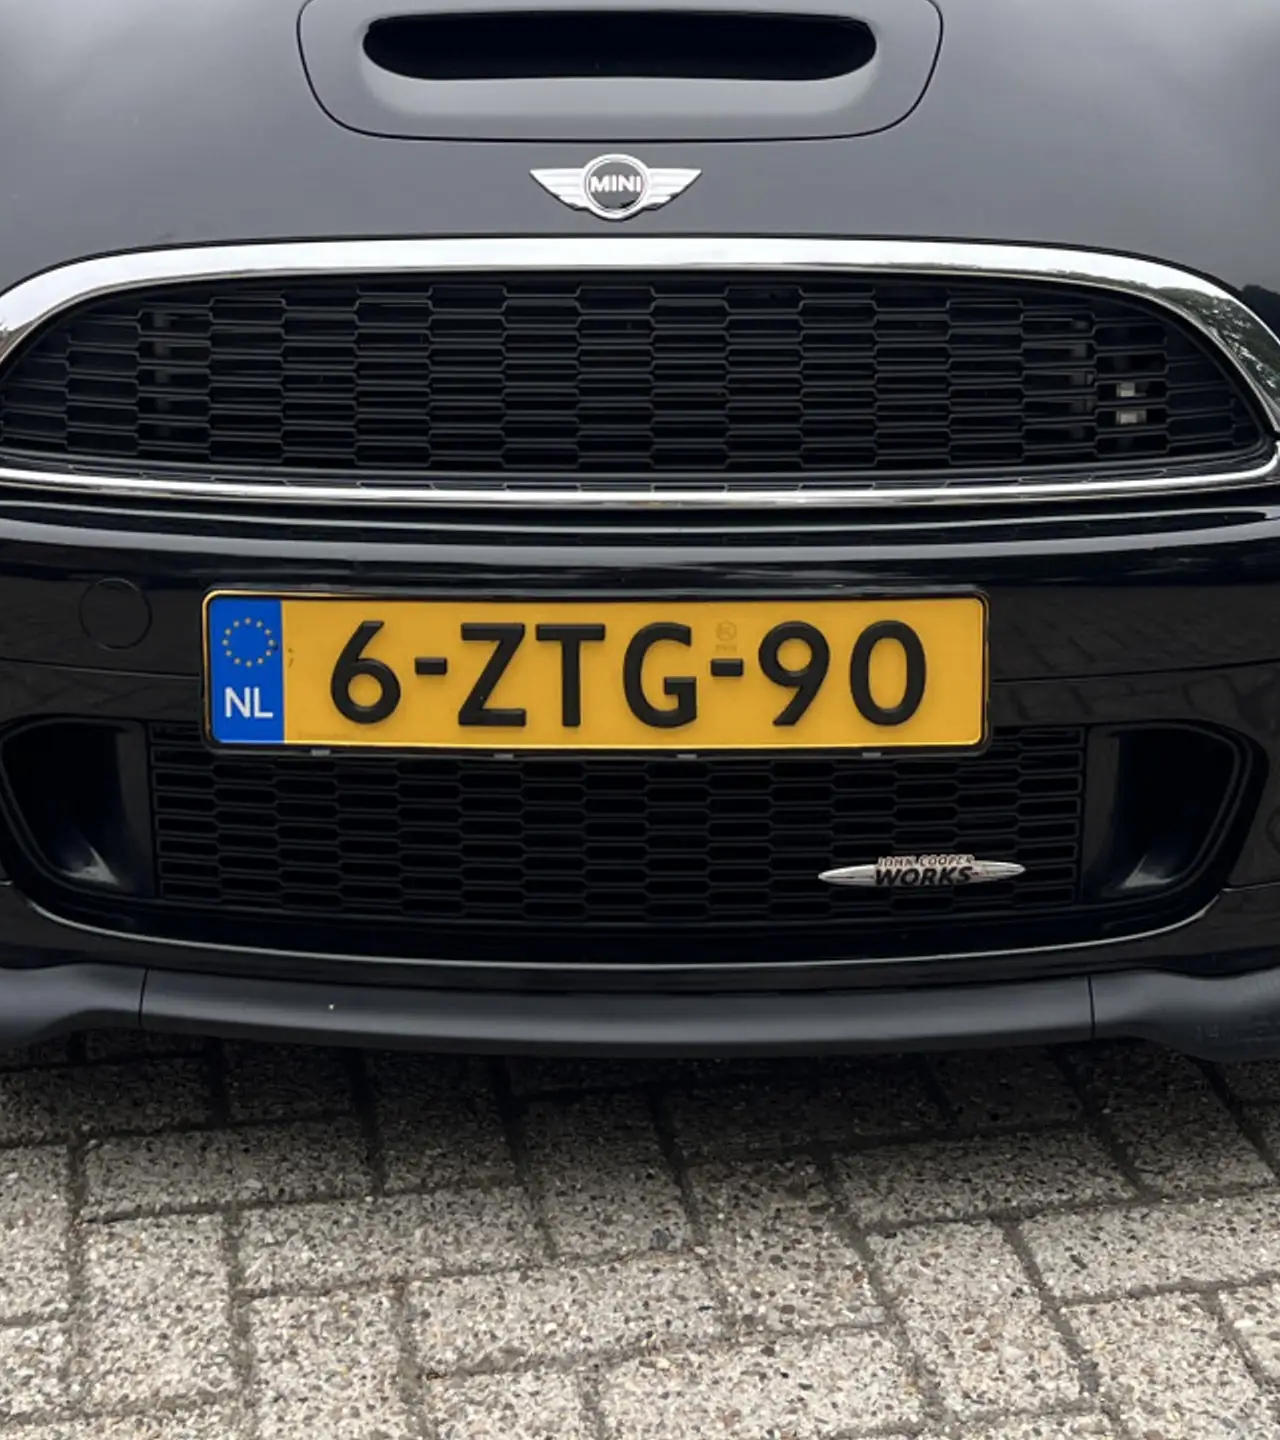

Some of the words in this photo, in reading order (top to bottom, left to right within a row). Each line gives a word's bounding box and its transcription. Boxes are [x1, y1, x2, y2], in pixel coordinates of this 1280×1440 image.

[590, 175, 641, 193] MINI
[330, 620, 928, 729] 6-ZTG-90
[224, 686, 273, 719] NL
[876, 856, 917, 868] JOHN
[919, 853, 975, 867] COOPER
[875, 866, 972, 886] WORKS
